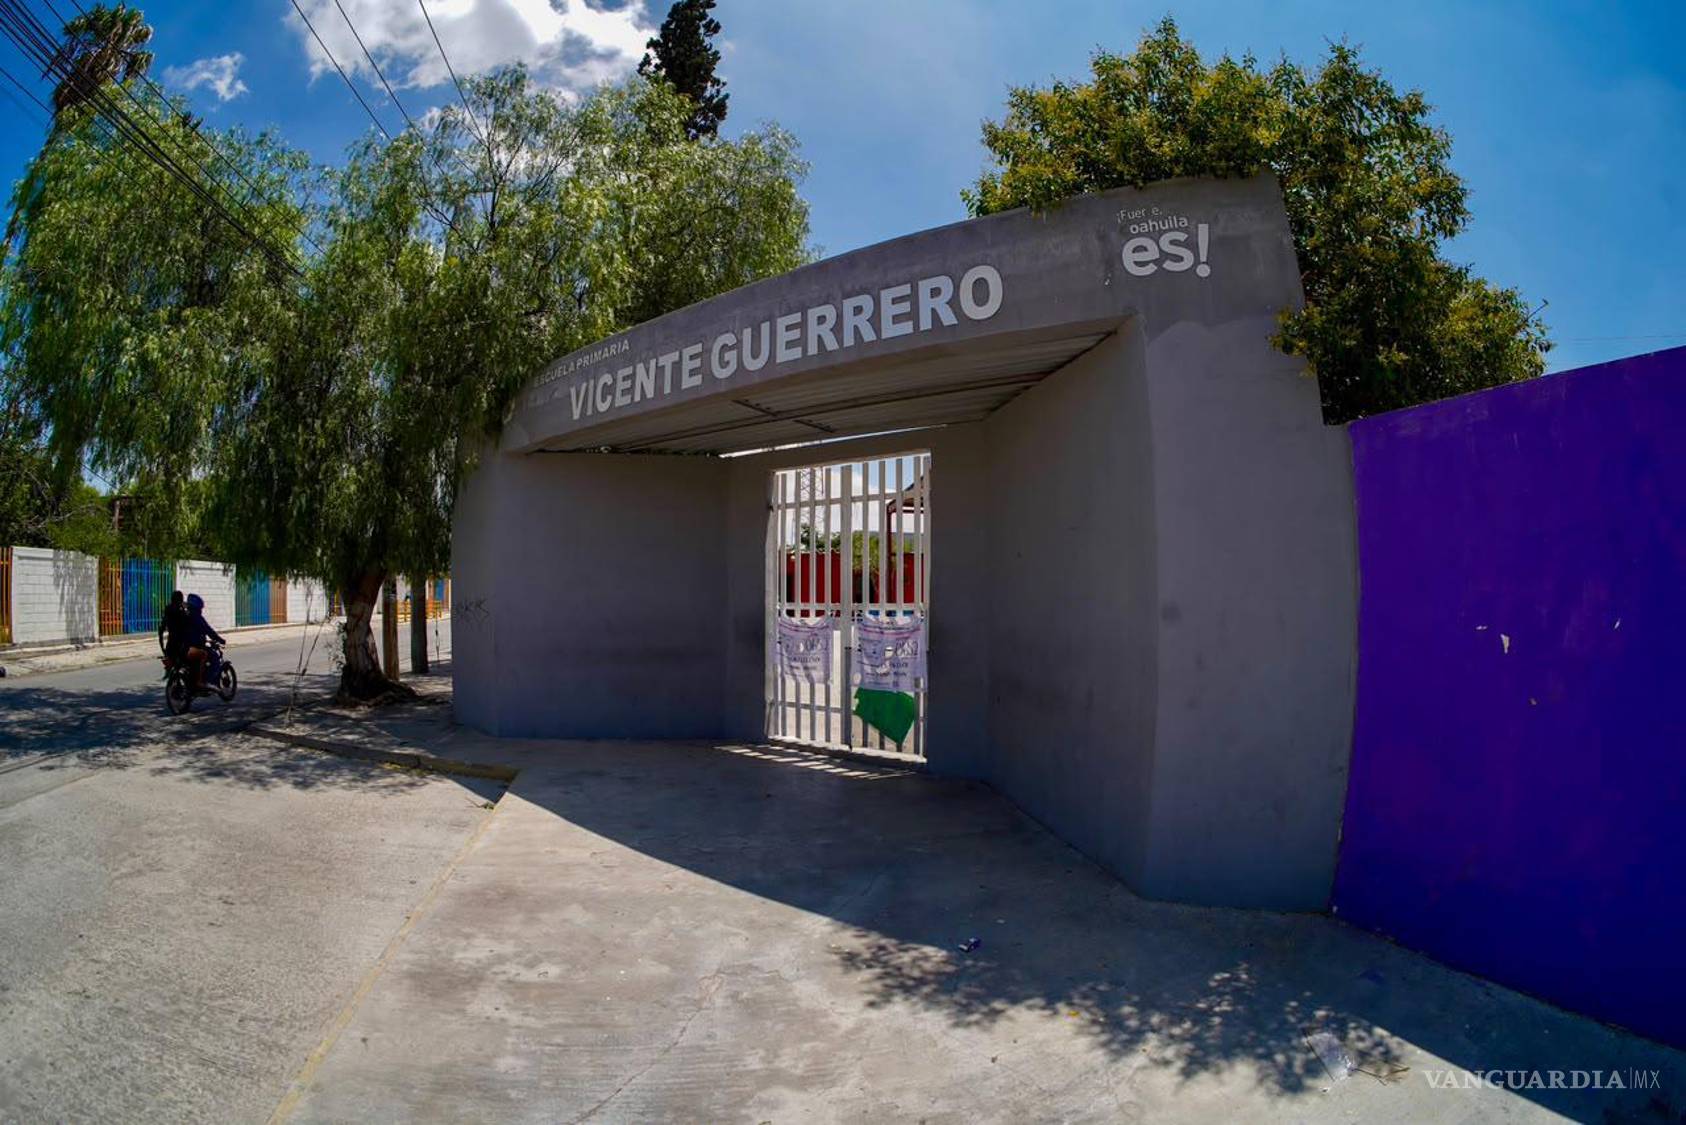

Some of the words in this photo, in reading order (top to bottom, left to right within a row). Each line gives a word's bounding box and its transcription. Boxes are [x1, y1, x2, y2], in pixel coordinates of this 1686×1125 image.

[1122, 223, 1211, 277] es!
[535, 361, 576, 388] ESCUELA
[576, 339, 630, 368] PRIMARIA
[569, 343, 703, 420] VICENTE
[710, 265, 1003, 379] GUERRERO
